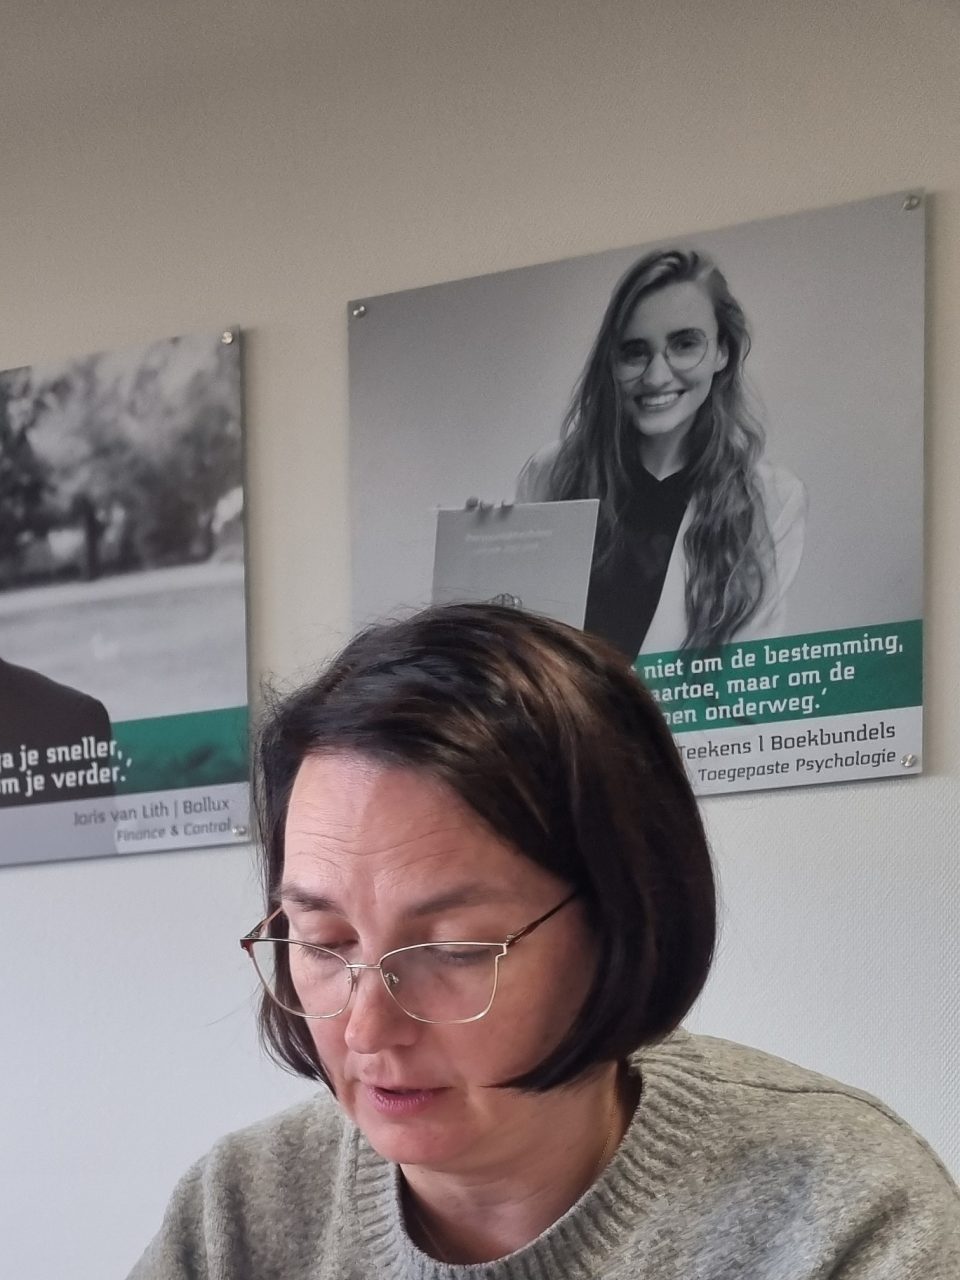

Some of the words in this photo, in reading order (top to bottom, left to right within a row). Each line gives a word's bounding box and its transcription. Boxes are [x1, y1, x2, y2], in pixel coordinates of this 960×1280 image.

[644, 659, 683, 679] niet
[691, 658, 723, 674] om
[731, 649, 756, 669] de
[764, 633, 903, 665] bestemming,
[651, 683, 719, 703] aartoe,
[727, 675, 780, 694] maar
[788, 669, 821, 687] om
[829, 662, 855, 681] de
[771, 722, 896, 750] Boekbundels
[19, 745, 39, 772] je
[46, 737, 123, 763] sneller,
[698, 759, 790, 782] Toegepaste
[796, 749, 896, 778] Psychologie
[26, 771, 45, 797] je
[111, 807, 137, 823] van
[142, 801, 168, 819] Lith
[183, 797, 229, 814] Bollux
[117, 826, 166, 842] Finance
[170, 822, 179, 836] &
[184, 817, 231, 836] Control
